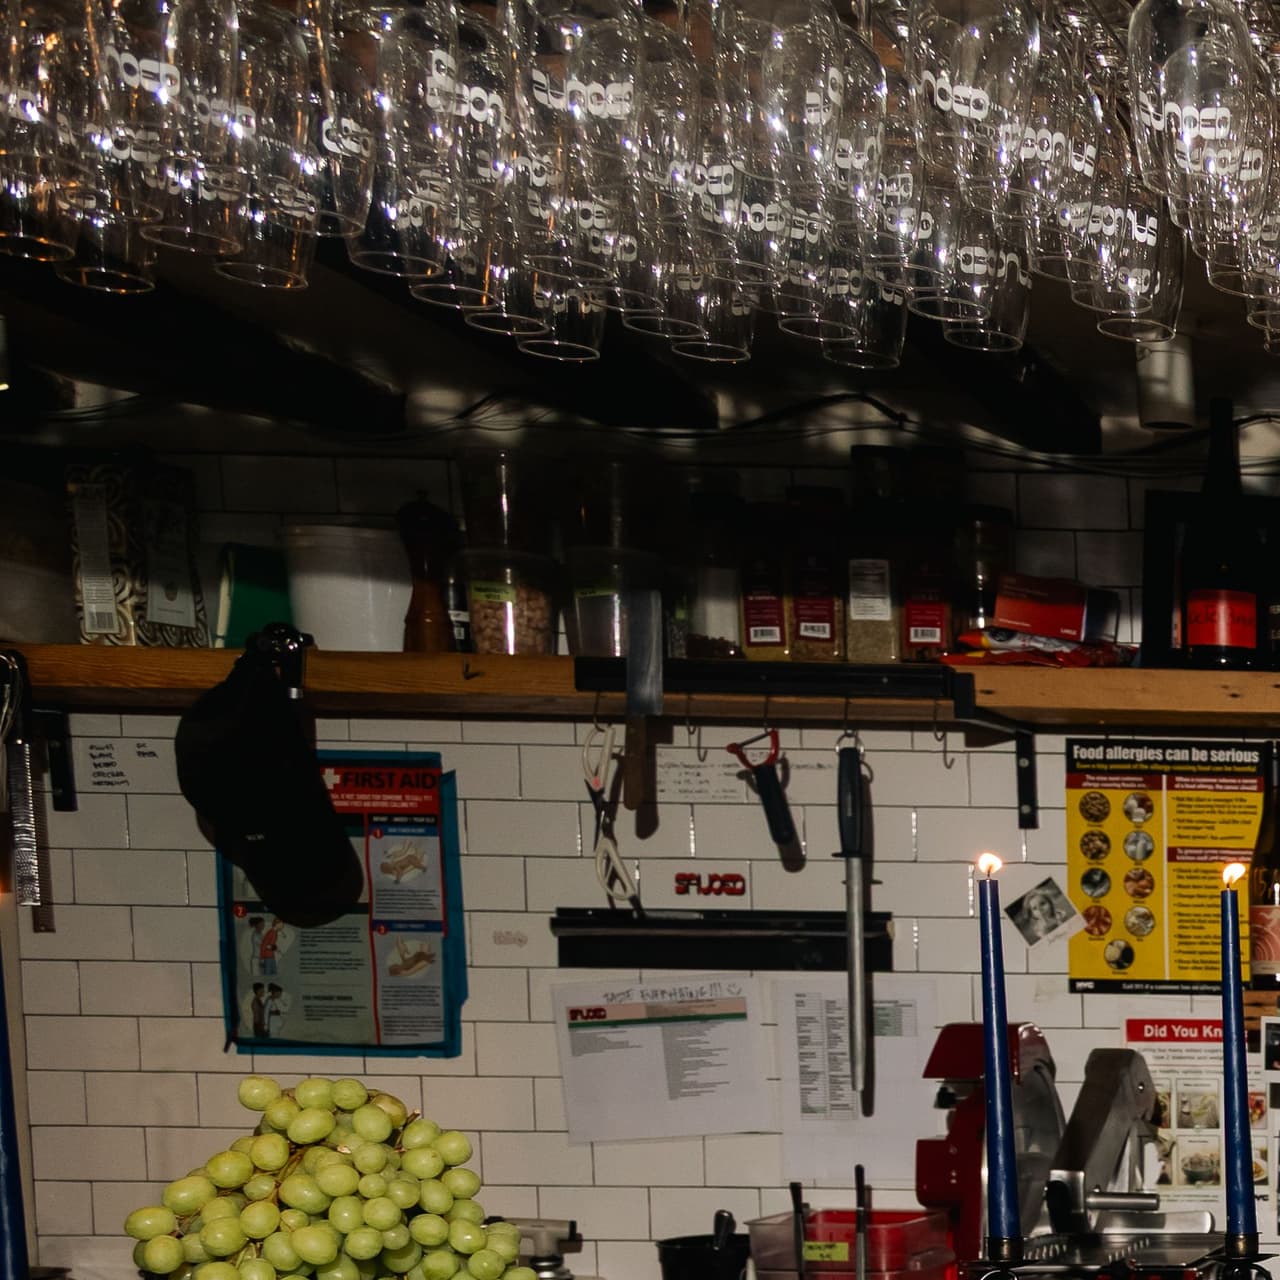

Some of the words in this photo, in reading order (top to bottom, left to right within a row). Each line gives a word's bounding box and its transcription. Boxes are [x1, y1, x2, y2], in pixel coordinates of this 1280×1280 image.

[1073, 746, 1101, 762] Food
[1106, 747, 1163, 764] allergies
[1165, 749, 1190, 764] can
[1191, 748, 1208, 765] be
[1210, 750, 1259, 766] serious
[341, 771, 395, 789] FIRST
[400, 771, 437, 789] AID
[1144, 1023, 1161, 1038] Did
[1171, 1024, 1198, 1038] You
[1203, 1024, 1222, 1038] Kn
